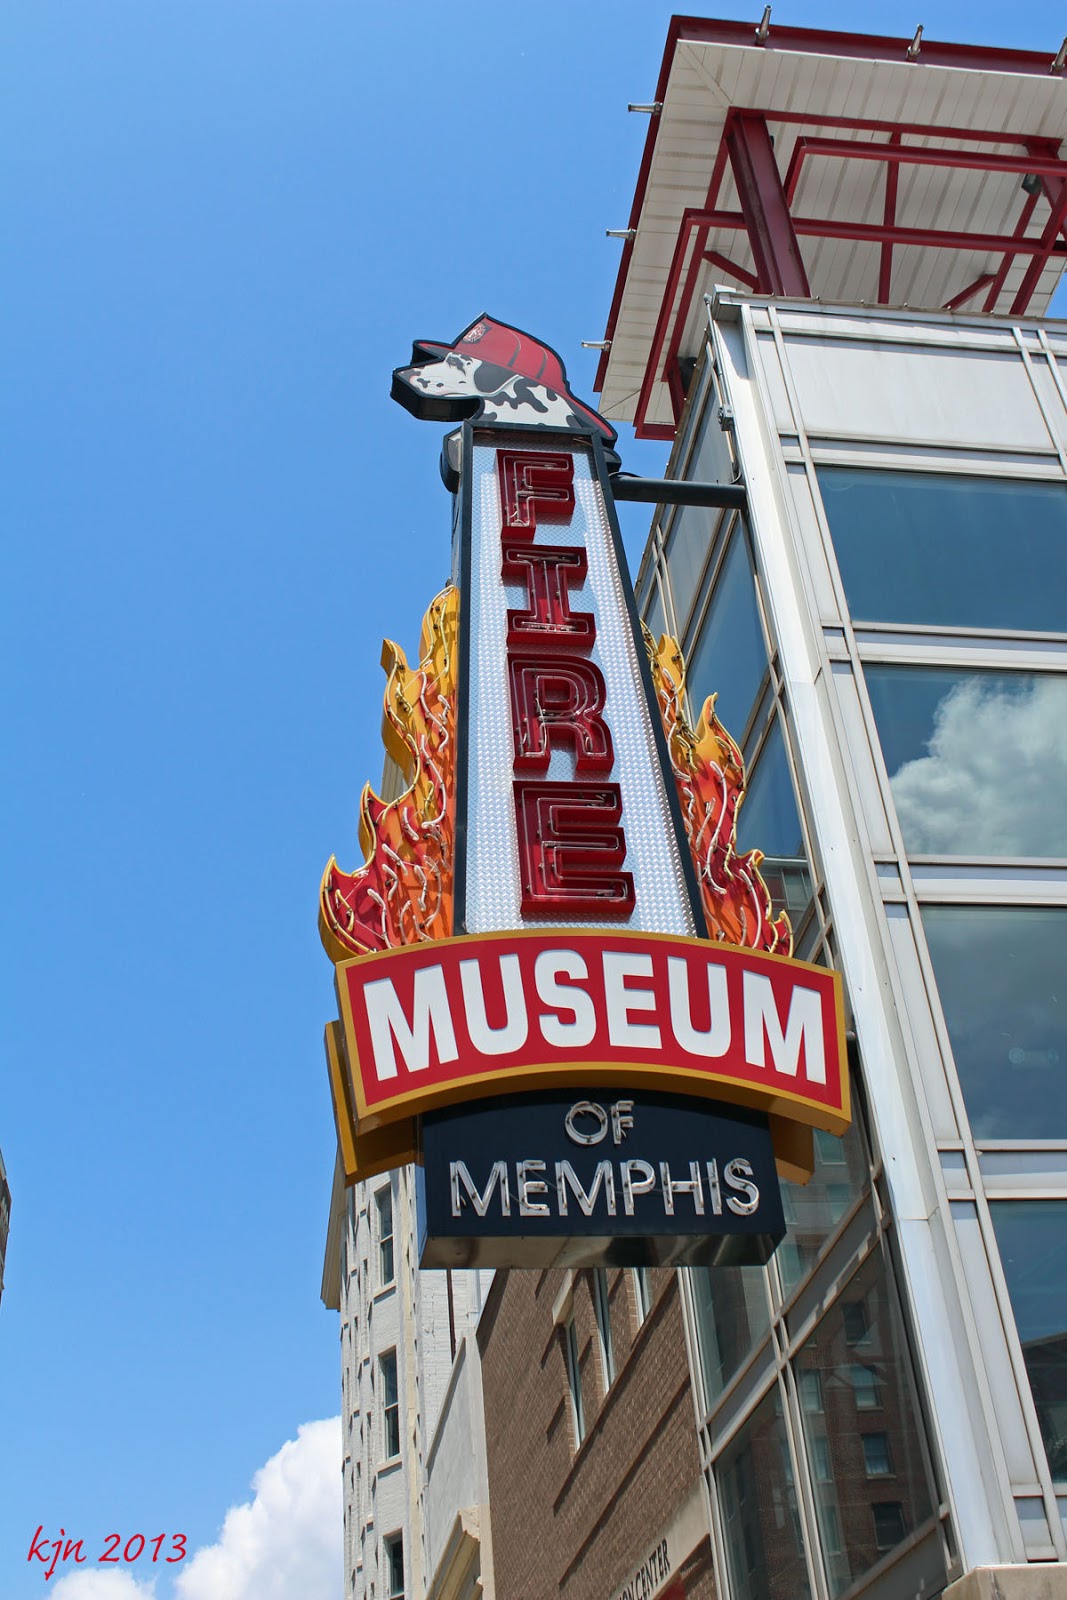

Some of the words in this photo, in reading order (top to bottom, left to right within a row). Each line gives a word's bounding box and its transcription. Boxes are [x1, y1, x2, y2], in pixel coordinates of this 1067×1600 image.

[496, 449, 636, 915] FIRE
[363, 949, 827, 1086] MUSEUM
[564, 1100, 635, 1146] OF
[450, 1158, 760, 1217] MEMPHIS
[635, 1538, 671, 1600] CENTER
